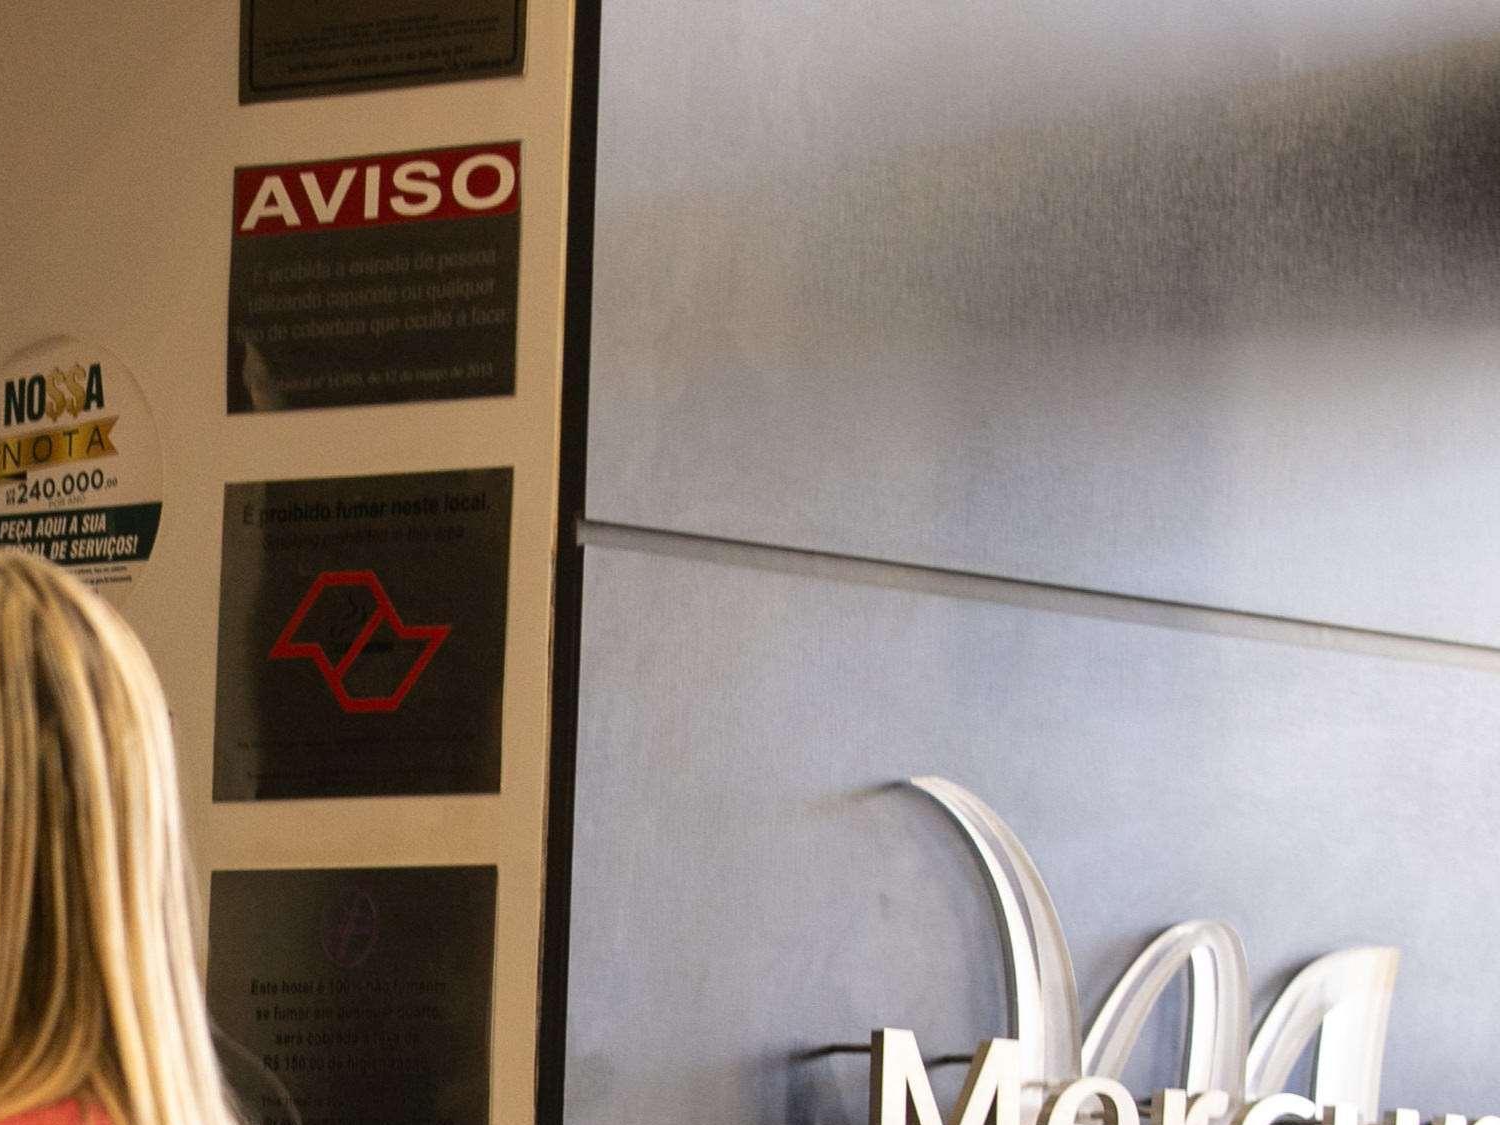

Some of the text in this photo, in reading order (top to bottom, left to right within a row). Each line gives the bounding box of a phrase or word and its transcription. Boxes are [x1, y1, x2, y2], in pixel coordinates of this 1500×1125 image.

[240, 154, 516, 231] AVISO
[1, 423, 108, 470] NOTA
[0, 511, 107, 543] PEÇA AQUI A SUA
[258, 499, 331, 528] proibido
[335, 498, 387, 521] fumar
[390, 496, 439, 517] neste
[50, 541, 68, 561] DE
[69, 534, 140, 560] SERVIÇOS!
